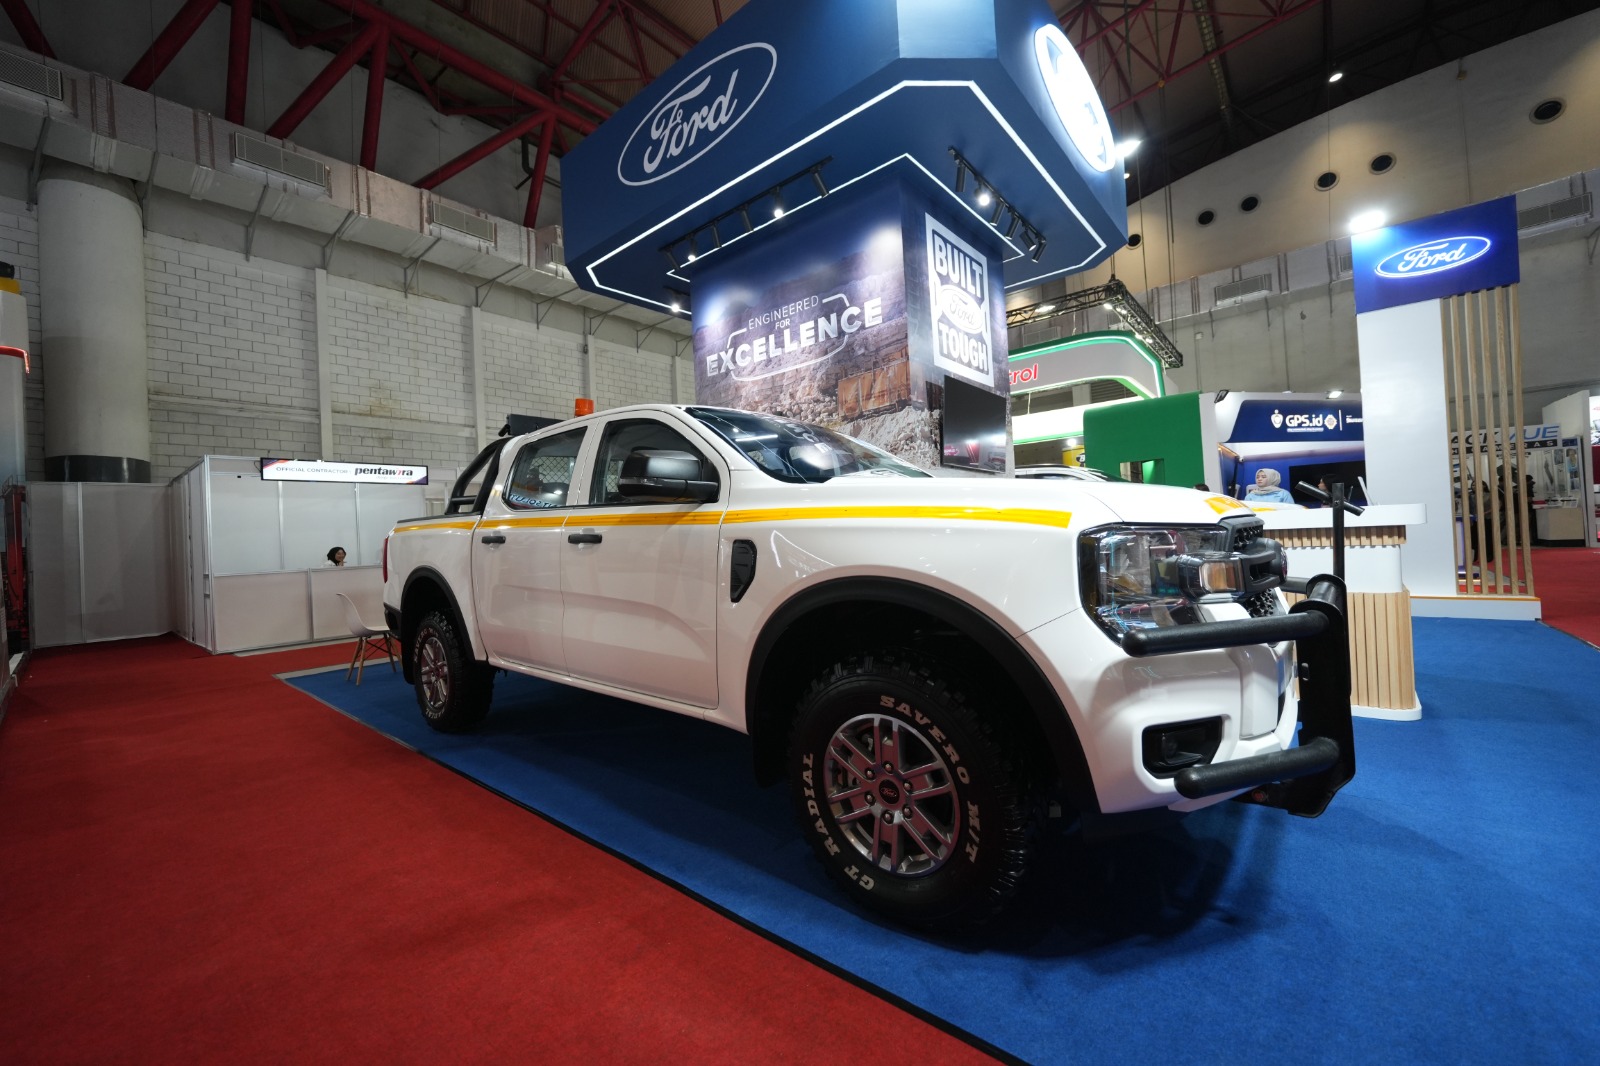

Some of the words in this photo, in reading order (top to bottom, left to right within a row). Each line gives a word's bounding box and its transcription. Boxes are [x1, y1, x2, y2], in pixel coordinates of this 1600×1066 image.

[643, 69, 740, 174] Ford
[933, 234, 983, 298] BUILT
[1397, 241, 1468, 273] Ford
[748, 295, 819, 330] ENGINEERED
[775, 318, 791, 330] FOR
[949, 295, 976, 326] Ford
[706, 296, 883, 377] EXCELLENCE
[938, 321, 988, 372] TOUGH
[1285, 414, 1323, 427] GPS.id
[879, 694, 970, 785] SAVERO
[965, 800, 982, 864] M/T
[802, 752, 841, 857] RADIAL
[843, 863, 875, 892] GT
